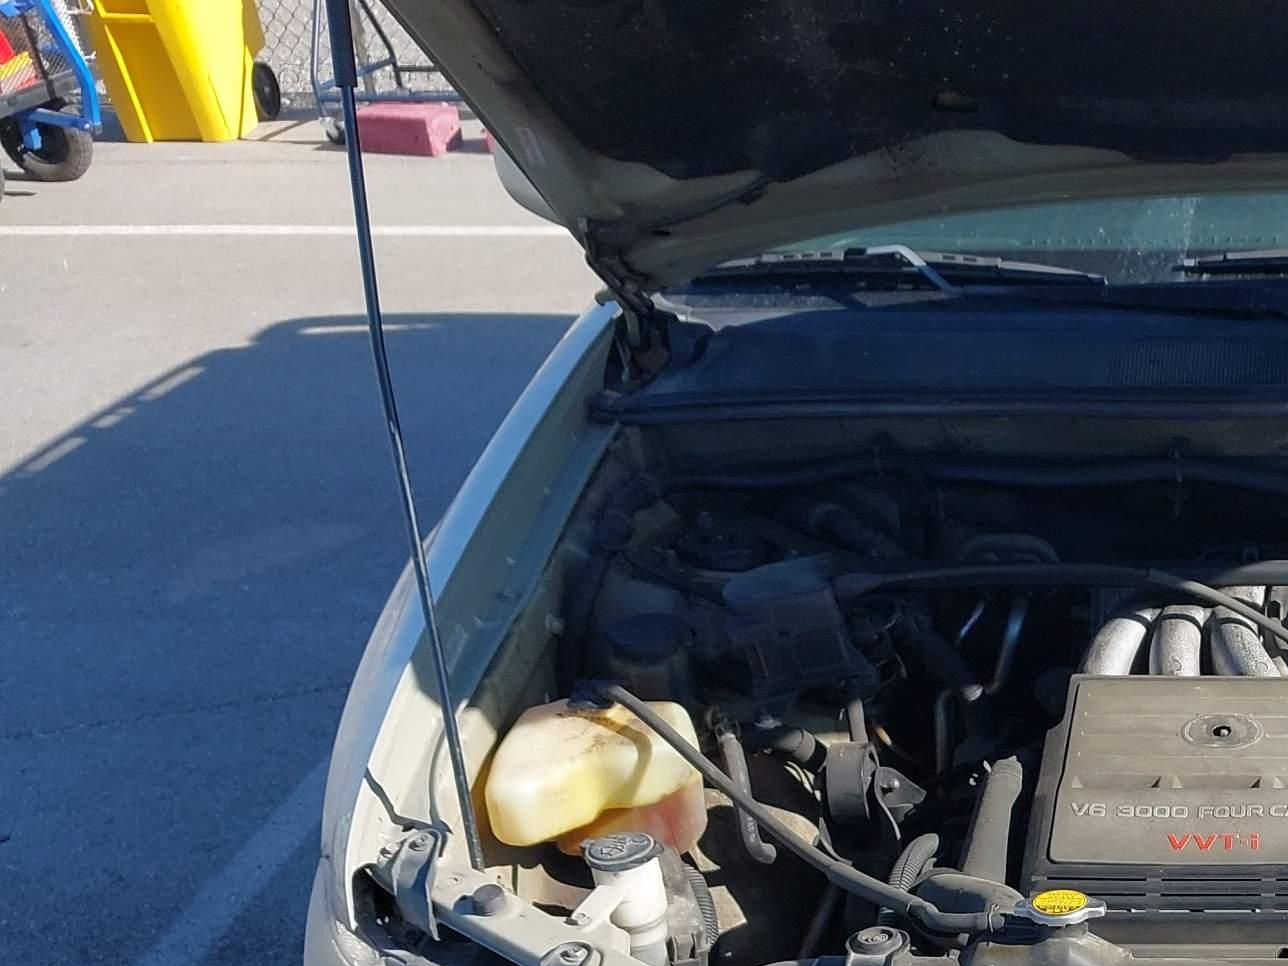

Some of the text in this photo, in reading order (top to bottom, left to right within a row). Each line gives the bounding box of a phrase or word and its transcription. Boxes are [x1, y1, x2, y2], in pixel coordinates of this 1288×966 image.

[1070, 802, 1107, 818] V6
[1116, 804, 1189, 819] 3000
[1199, 804, 1265, 819] FOUR
